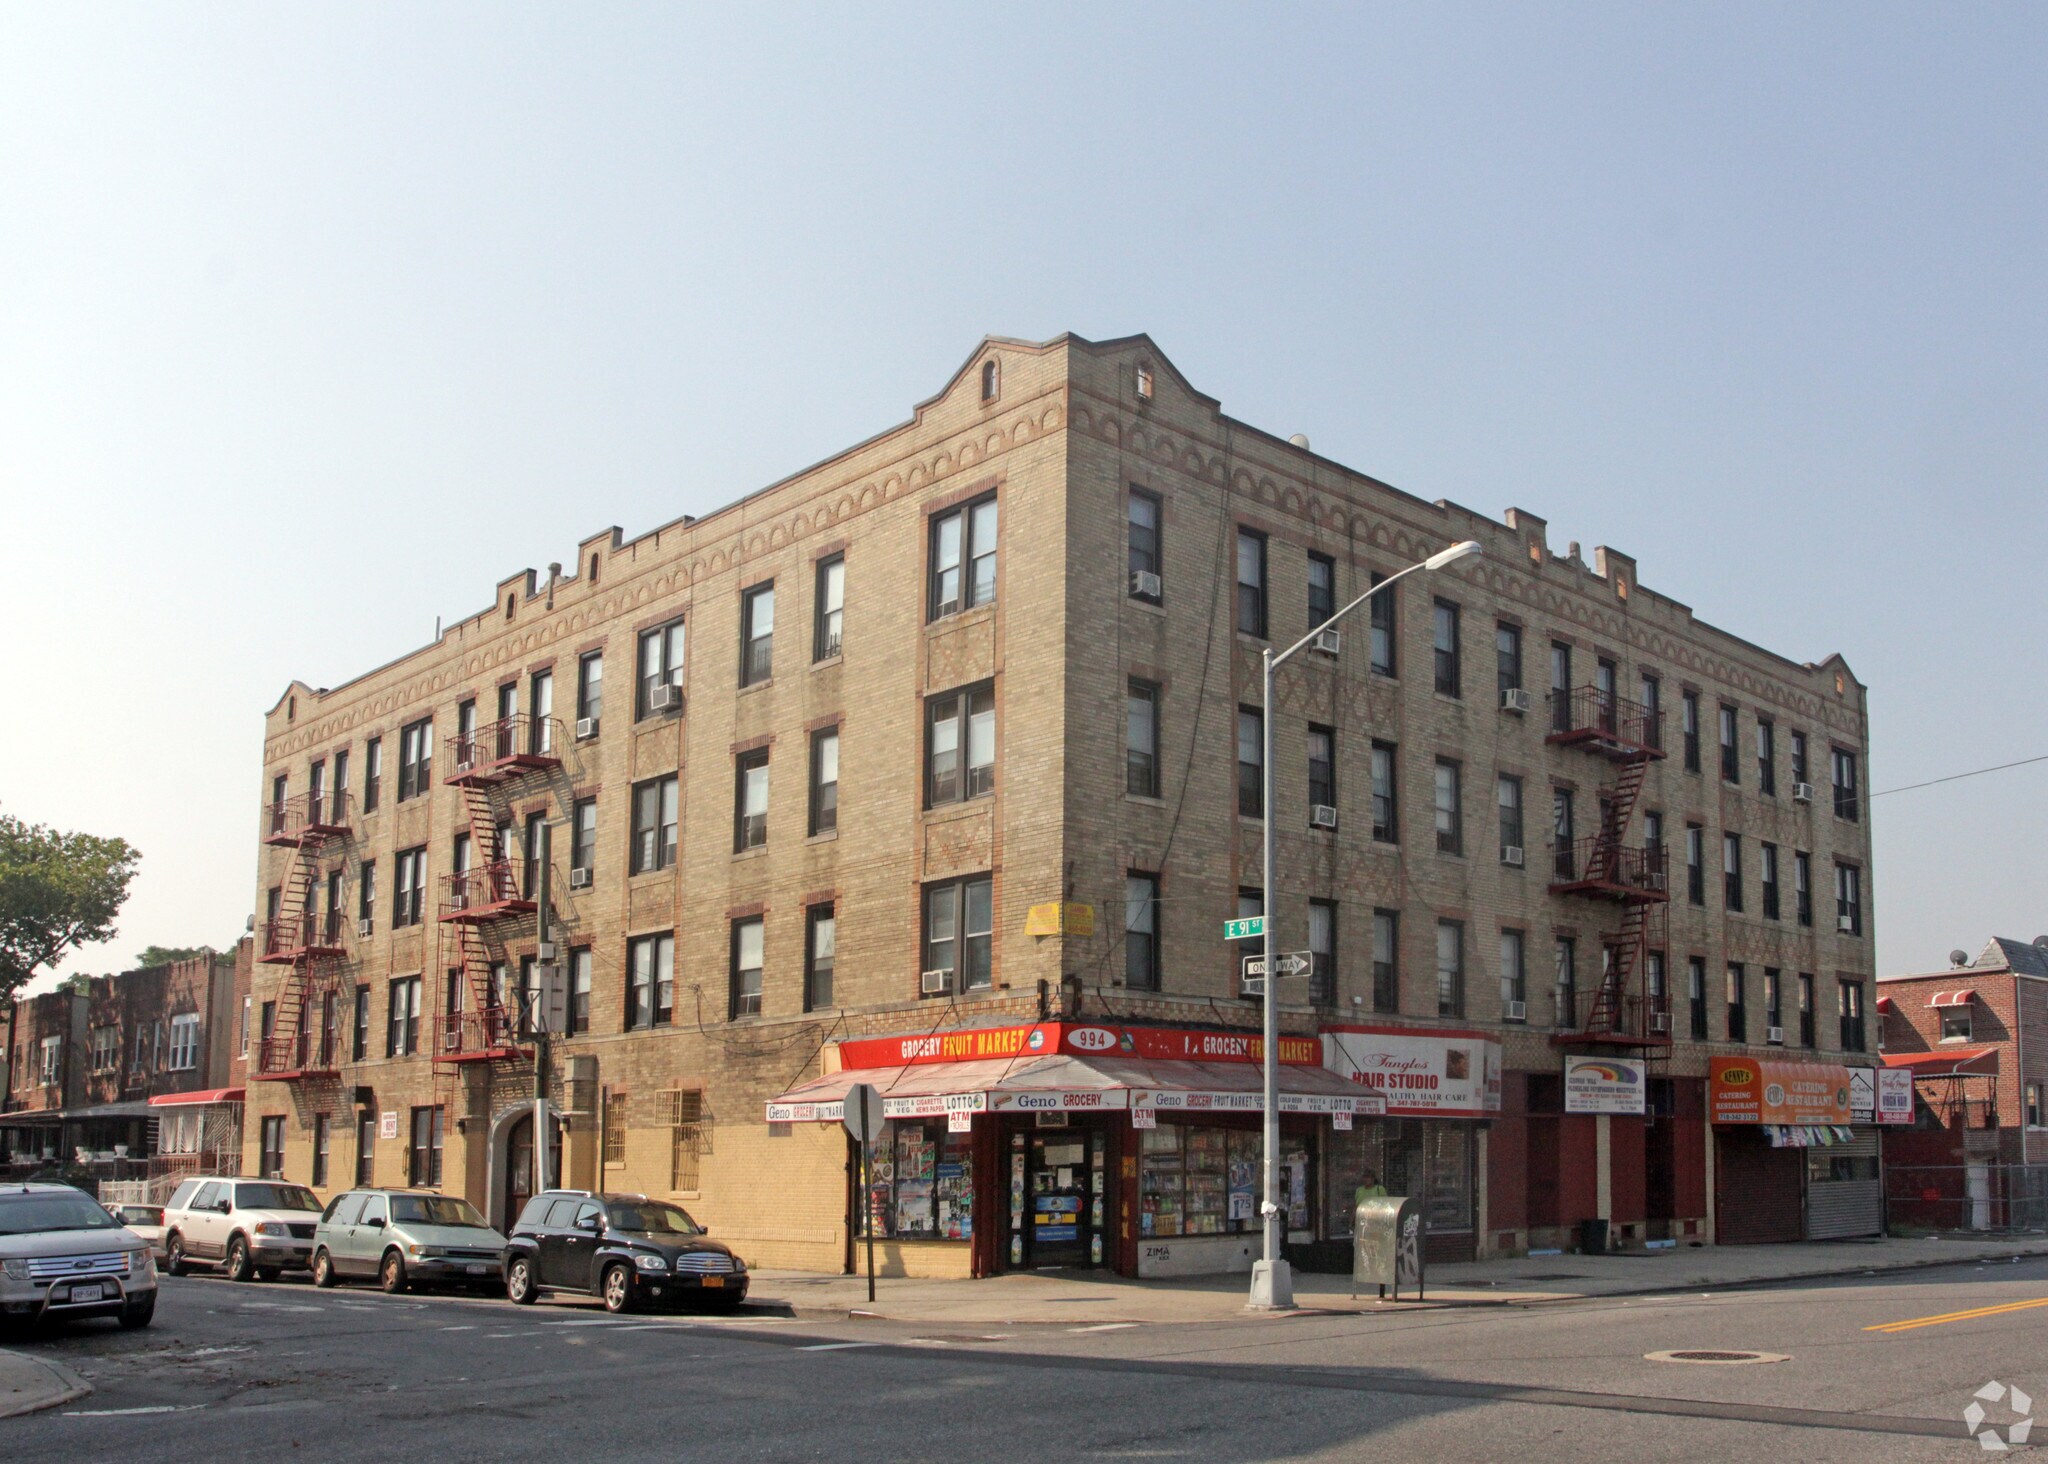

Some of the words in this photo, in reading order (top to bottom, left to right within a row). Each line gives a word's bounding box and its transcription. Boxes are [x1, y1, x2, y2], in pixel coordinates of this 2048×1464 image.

[1229, 923, 1236, 937] E
[1239, 921, 1249, 935] 91
[1252, 919, 1260, 928] ST
[1252, 963, 1265, 973] ON
[1281, 960, 1301, 971] WAY
[901, 1037, 941, 1059] GROCERY
[943, 1034, 973, 1057] FRUIT
[977, 1029, 1025, 1055] MARKET
[1080, 1031, 1105, 1047] 994
[1203, 1036, 1249, 1056] GROCERY
[1278, 1041, 1314, 1061] MARKET
[1352, 1071, 1385, 1089] HAIR
[1388, 1073, 1439, 1090] STUDIO
[1792, 1081, 1828, 1093] CATERING
[916, 1098, 942, 1106] CIGARETTE
[946, 1096, 973, 1110] LOTTO
[1018, 1094, 1056, 1108] Geno
[1063, 1094, 1101, 1107] GROCERY
[1156, 1093, 1181, 1106] Geno
[1186, 1094, 1213, 1107] GROCERY
[1214, 1095, 1229, 1107] FRUIT
[1230, 1096, 1252, 1107] MARKET
[1388, 1092, 1416, 1101] ALTHY
[1420, 1093, 1442, 1102] HAIR
[1445, 1094, 1468, 1103] CARE
[1786, 1094, 1833, 1107] RESTAURANT
[1330, 1099, 1352, 1111] LOTTO
[1715, 1102, 1759, 1110] RESTAURANT
[768, 1106, 790, 1119] Geno
[793, 1105, 815, 1118] GROCERY
[950, 1111, 970, 1121] ATM
[1134, 1109, 1153, 1119] ATM
[1334, 1112, 1351, 1121] ATM
[1146, 1247, 1170, 1257] ZIMA
